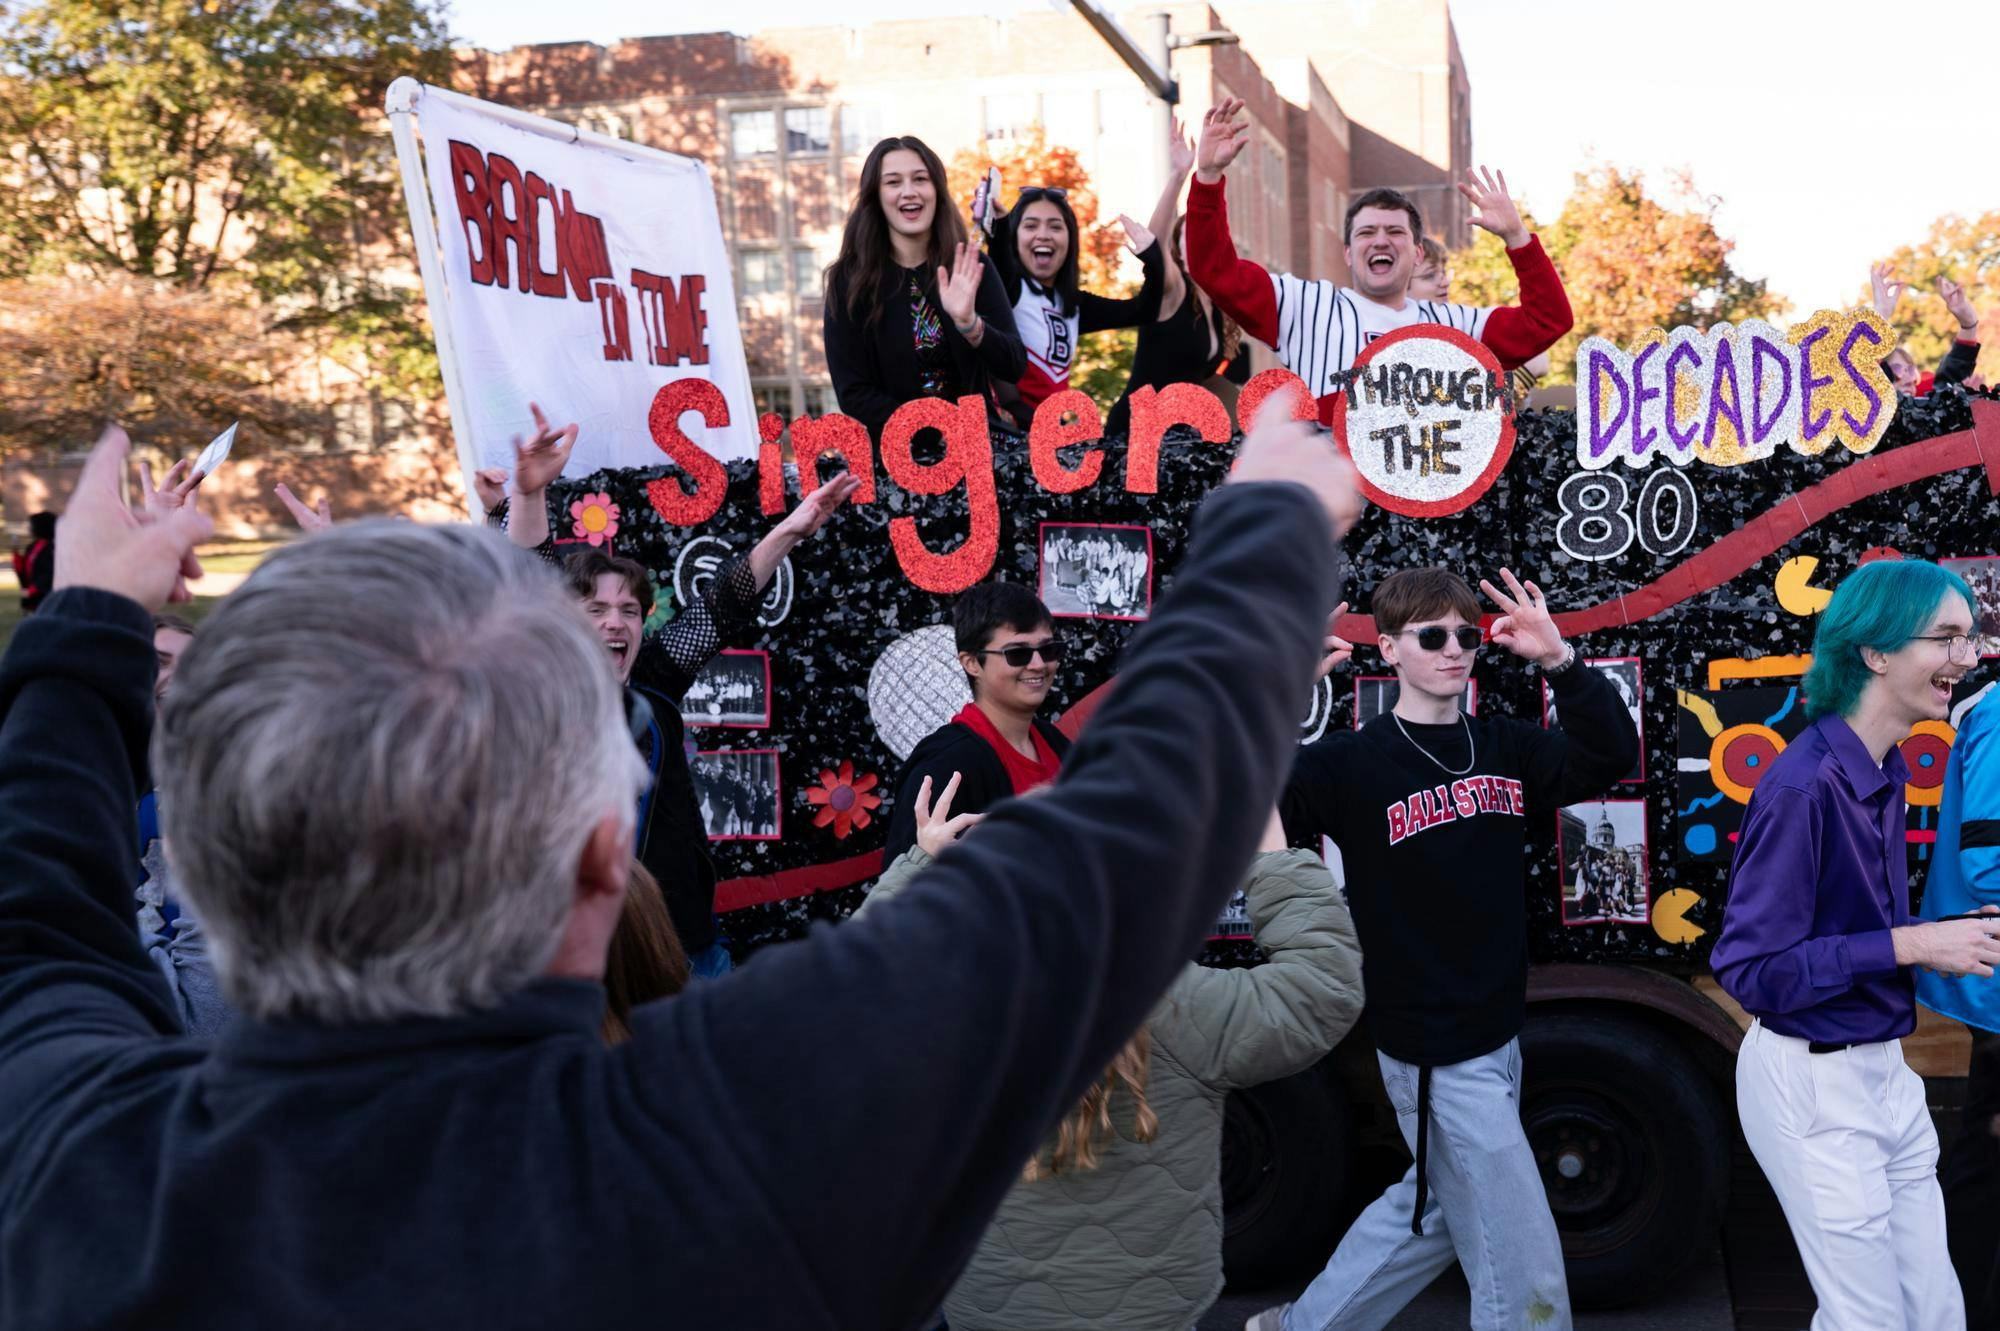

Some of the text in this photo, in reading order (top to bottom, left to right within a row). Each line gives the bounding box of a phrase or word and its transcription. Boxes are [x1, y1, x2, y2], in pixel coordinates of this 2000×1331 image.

[631, 267, 710, 367] TIME
[1041, 306, 1073, 369] B
[1329, 361, 1515, 417] THROUGH
[1588, 320, 1882, 459] DECADES
[1369, 419, 1462, 478] THE
[1556, 467, 1698, 562] 80
[1387, 775, 1525, 846] BALL STATE
